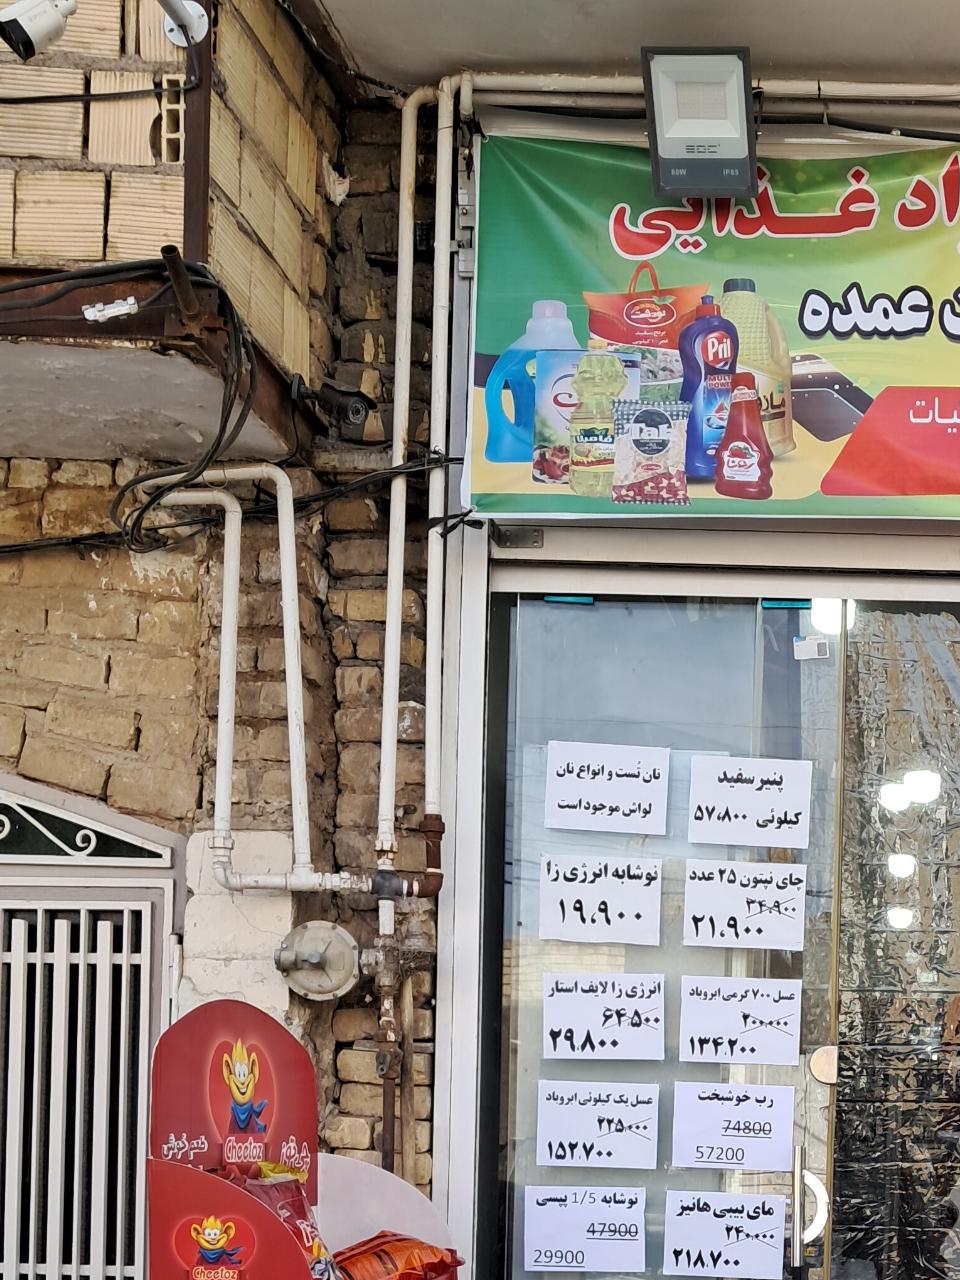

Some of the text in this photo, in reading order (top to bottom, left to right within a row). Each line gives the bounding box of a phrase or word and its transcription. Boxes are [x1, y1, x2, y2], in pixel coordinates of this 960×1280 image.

[800, 282, 932, 342] عمده
[707, 337, 731, 360] Pril
[555, 761, 575, 778] نان
[575, 763, 605, 780] انواع
[641, 767, 661, 784] نان
[717, 767, 784, 794] پنیر سفید
[557, 797, 653, 819] لواش موجود است
[545, 859, 659, 888] نوشابه انرژی زا
[688, 869, 715, 882] عدد
[717, 867, 737, 885] ۲۵
[775, 872, 805, 892] چای
[547, 979, 662, 1000] انرژی لایف استار
[751, 987, 771, 1001] ۷۰۰
[772, 989, 796, 1004] عسل
[614, 1093, 654, 1108] عسل یک
[697, 1088, 774, 1109] رب خوشبخت
[720, 1119, 773, 1137] 74800
[225, 1137, 263, 1162] Cheetoz
[693, 1145, 745, 1163] 57200
[535, 1189, 639, 1209] نوشابه 1/5 پپسی
[675, 1197, 775, 1221] مای بیبی هانیز
[585, 1222, 640, 1238] 47900
[533, 1249, 585, 1265] 29900
